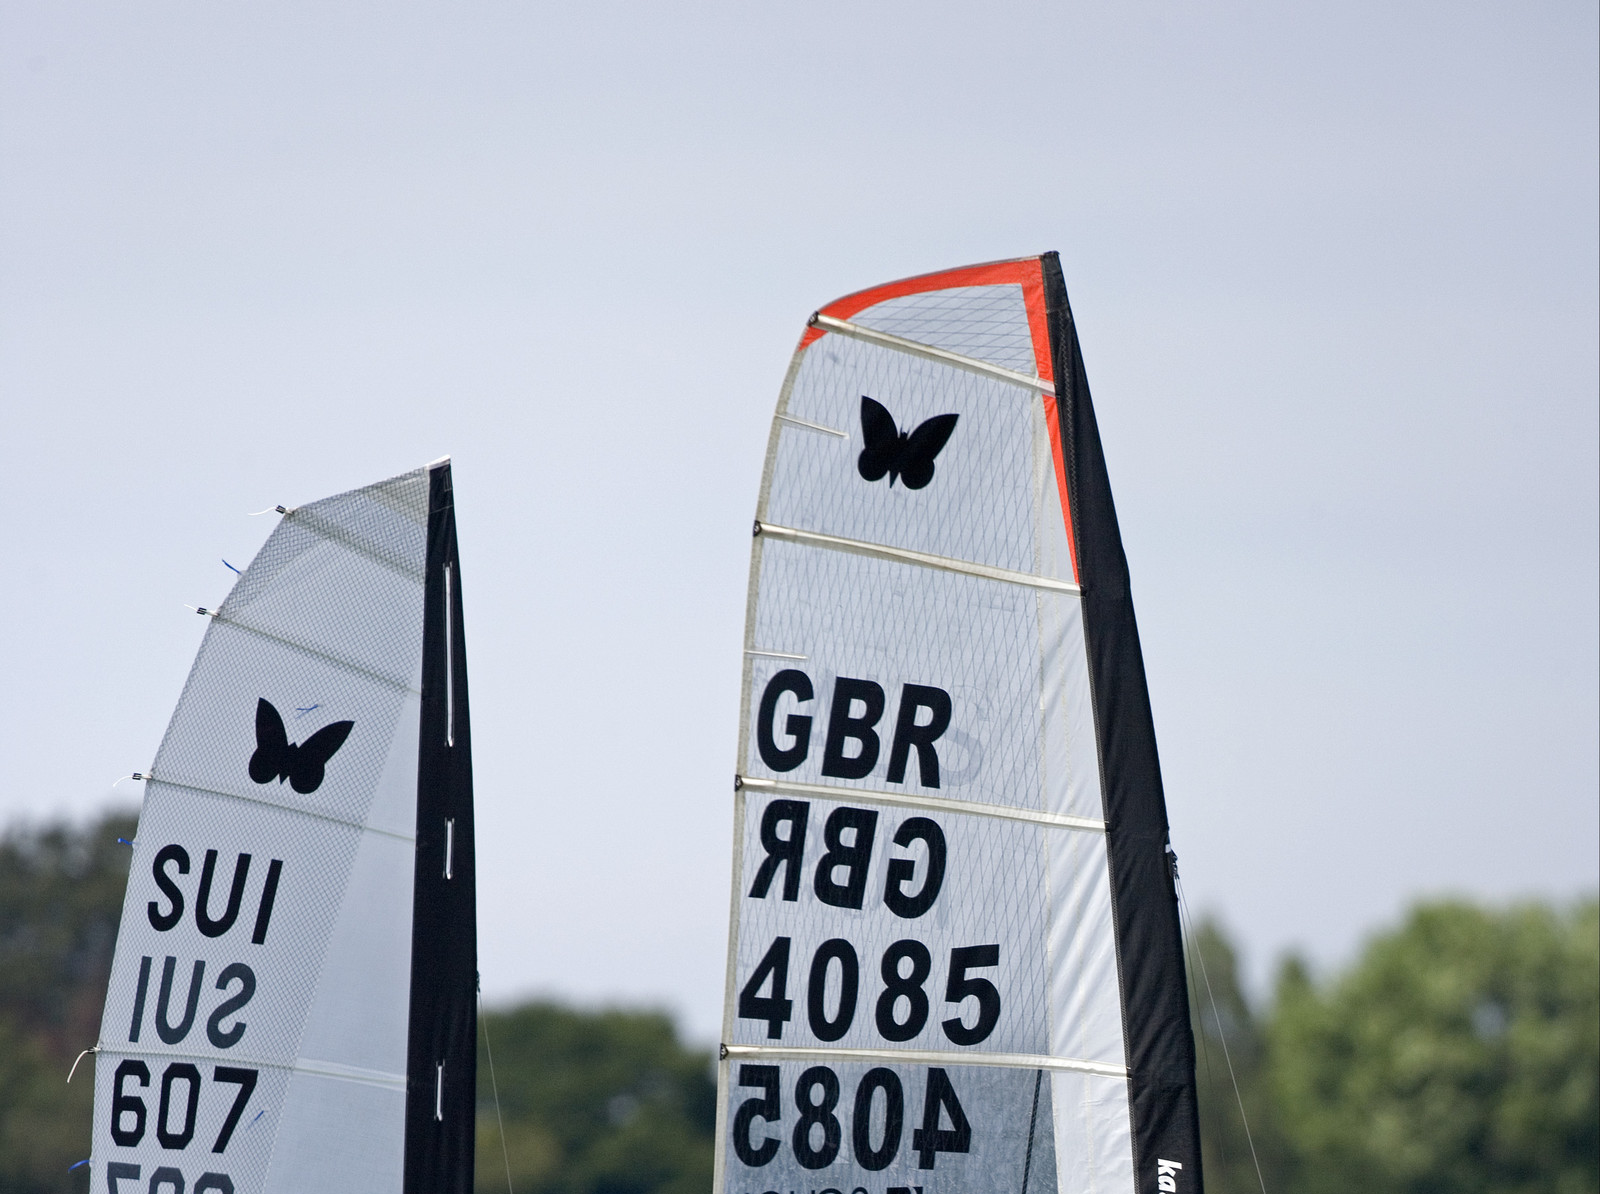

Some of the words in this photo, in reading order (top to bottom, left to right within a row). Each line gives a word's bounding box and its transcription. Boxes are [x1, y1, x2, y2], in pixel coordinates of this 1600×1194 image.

[757, 668, 953, 789] GBR
[147, 843, 284, 945] SUI
[738, 935, 1002, 1047] 4085
[110, 1059, 259, 1154] 607
